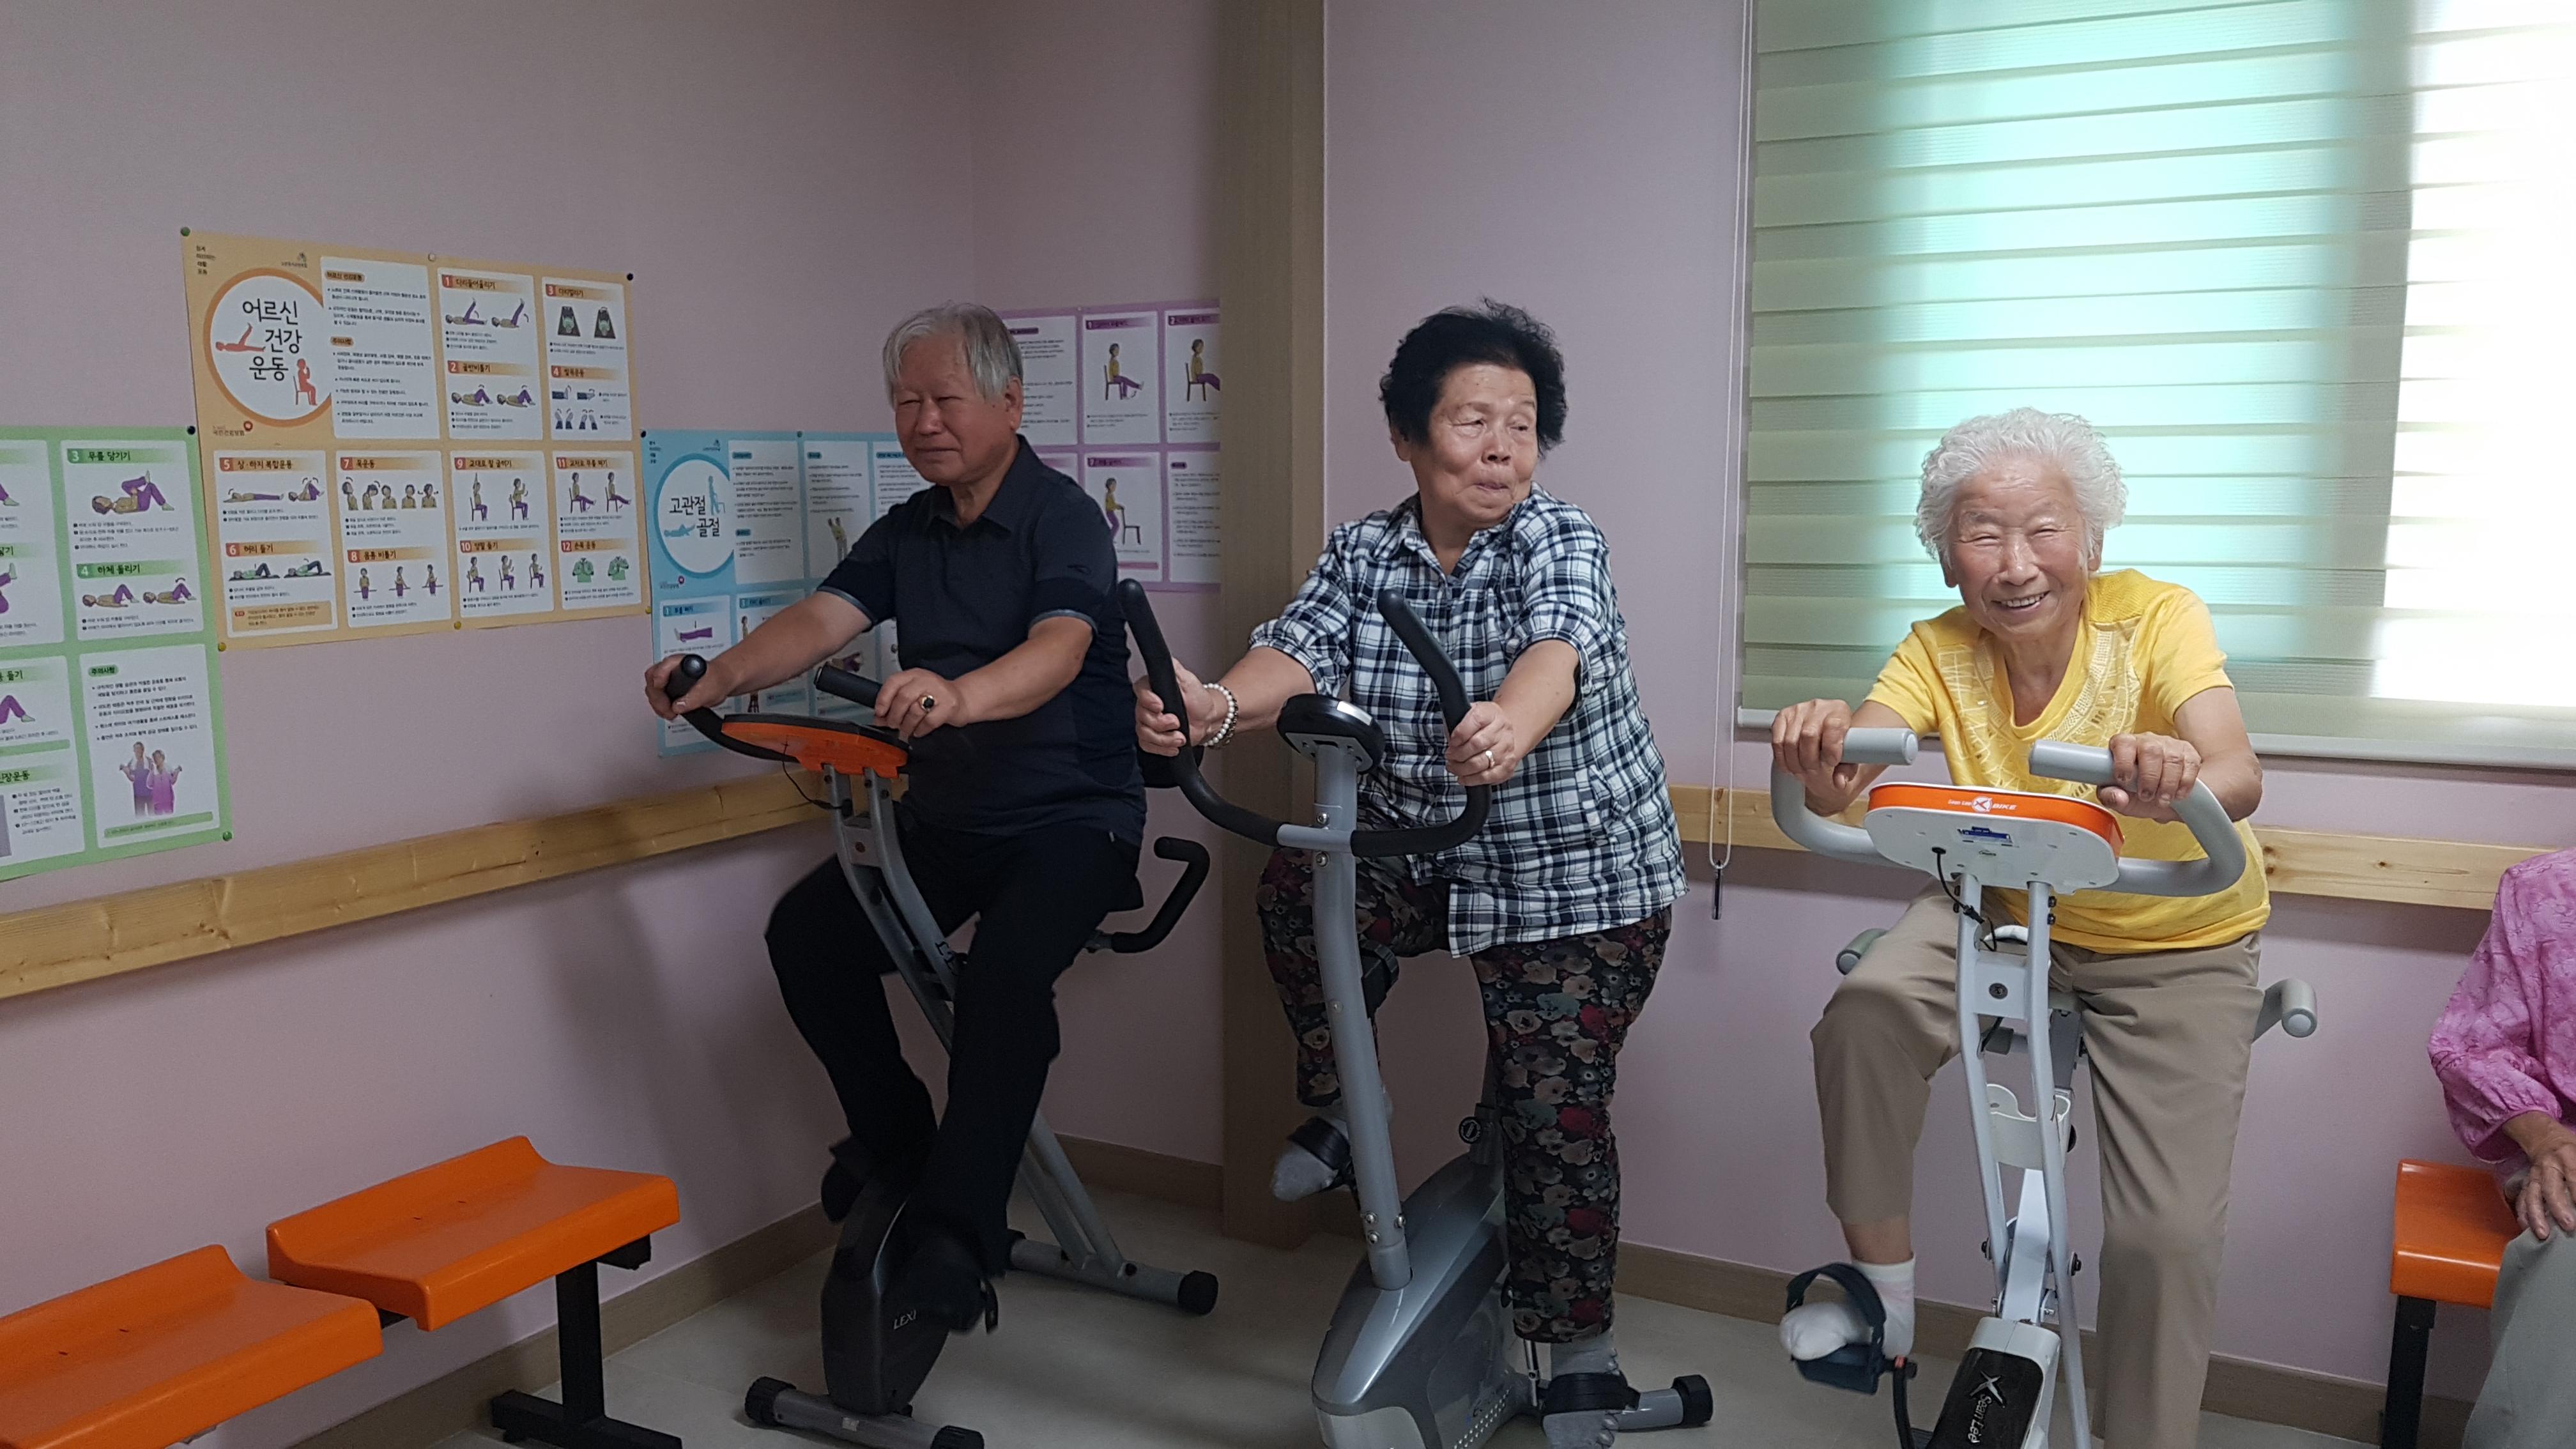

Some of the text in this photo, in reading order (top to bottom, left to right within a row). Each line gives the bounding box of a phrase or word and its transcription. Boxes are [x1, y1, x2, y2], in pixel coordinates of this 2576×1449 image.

[446, 277, 450, 287] 1
[548, 286, 553, 295] 3
[243, 298, 298, 325] 어르신
[265, 328, 303, 354] 건강
[249, 356, 289, 381] 운동
[451, 362, 456, 372] 2
[553, 367, 559, 376] 4
[72, 450, 130, 461] 3 무릎 당기기
[224, 459, 230, 470] 5
[344, 459, 349, 468] 7
[457, 459, 463, 468] 9
[557, 459, 565, 469] 11
[669, 495, 706, 516] 고관절
[696, 518, 720, 537] 골절
[230, 545, 236, 555] 6
[243, 545, 257, 554] 허리
[461, 542, 471, 552] 10
[562, 542, 571, 551] 12
[351, 551, 357, 561] 8
[80, 565, 89, 576] 4
